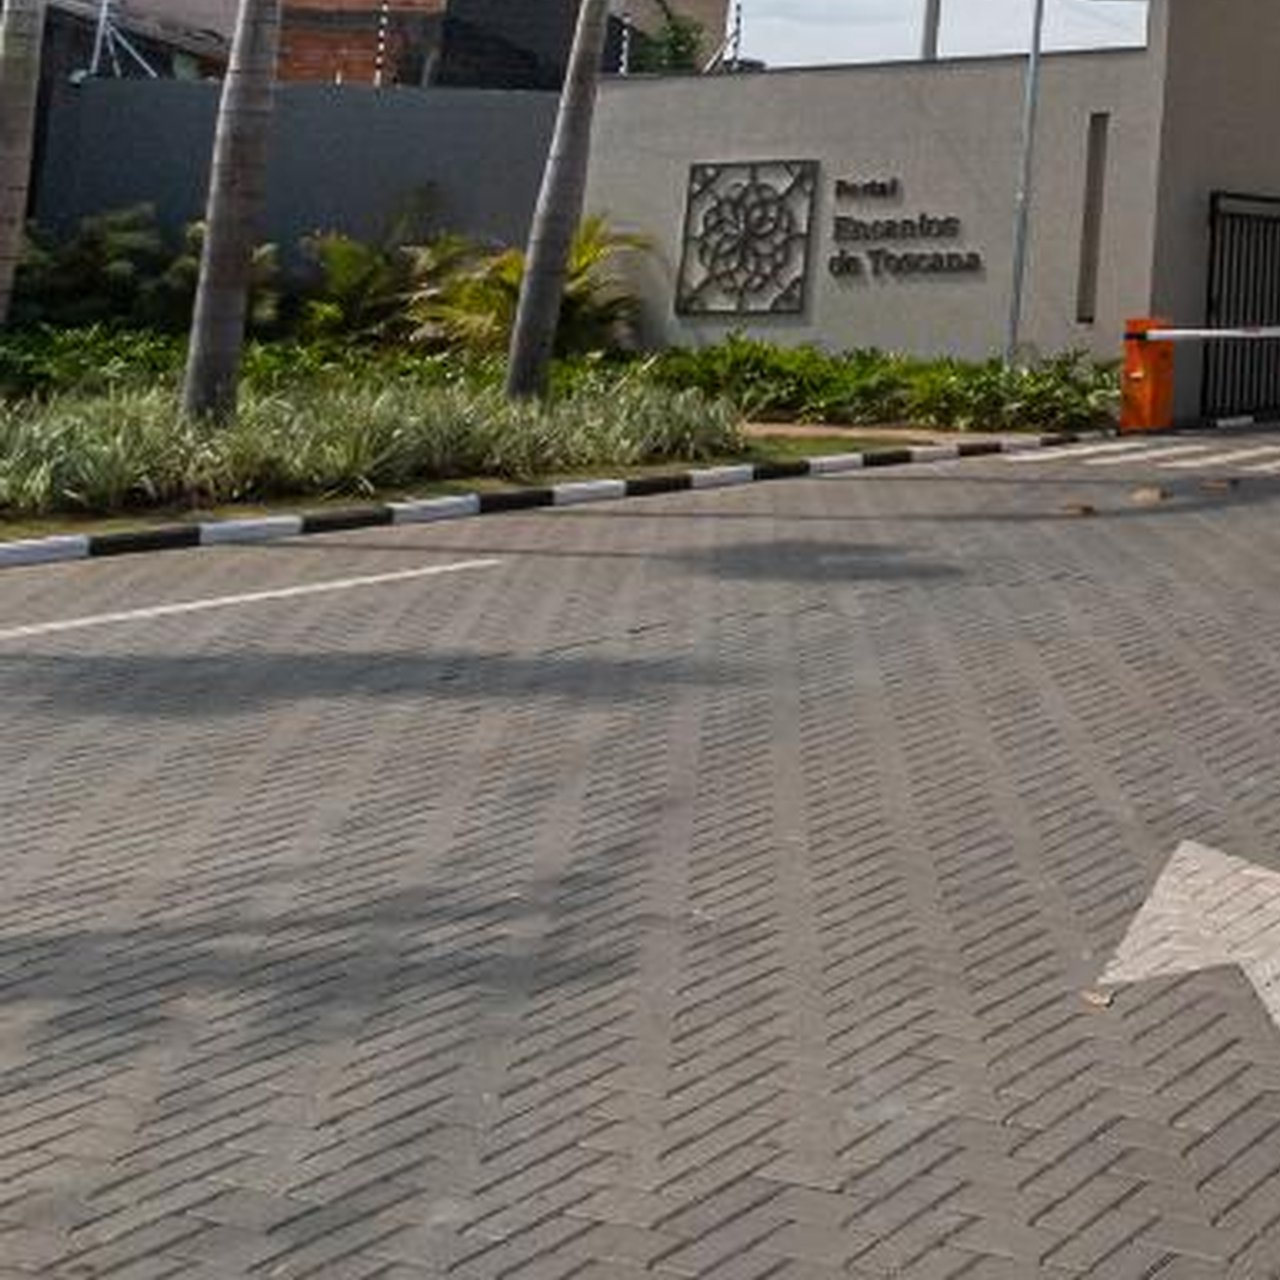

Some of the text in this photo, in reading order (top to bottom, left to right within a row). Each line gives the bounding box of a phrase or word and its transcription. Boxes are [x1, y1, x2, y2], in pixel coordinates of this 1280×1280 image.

[835, 177, 899, 199] Portal
[833, 213, 961, 242] Encantos
[829, 248, 982, 277] de Toscana
